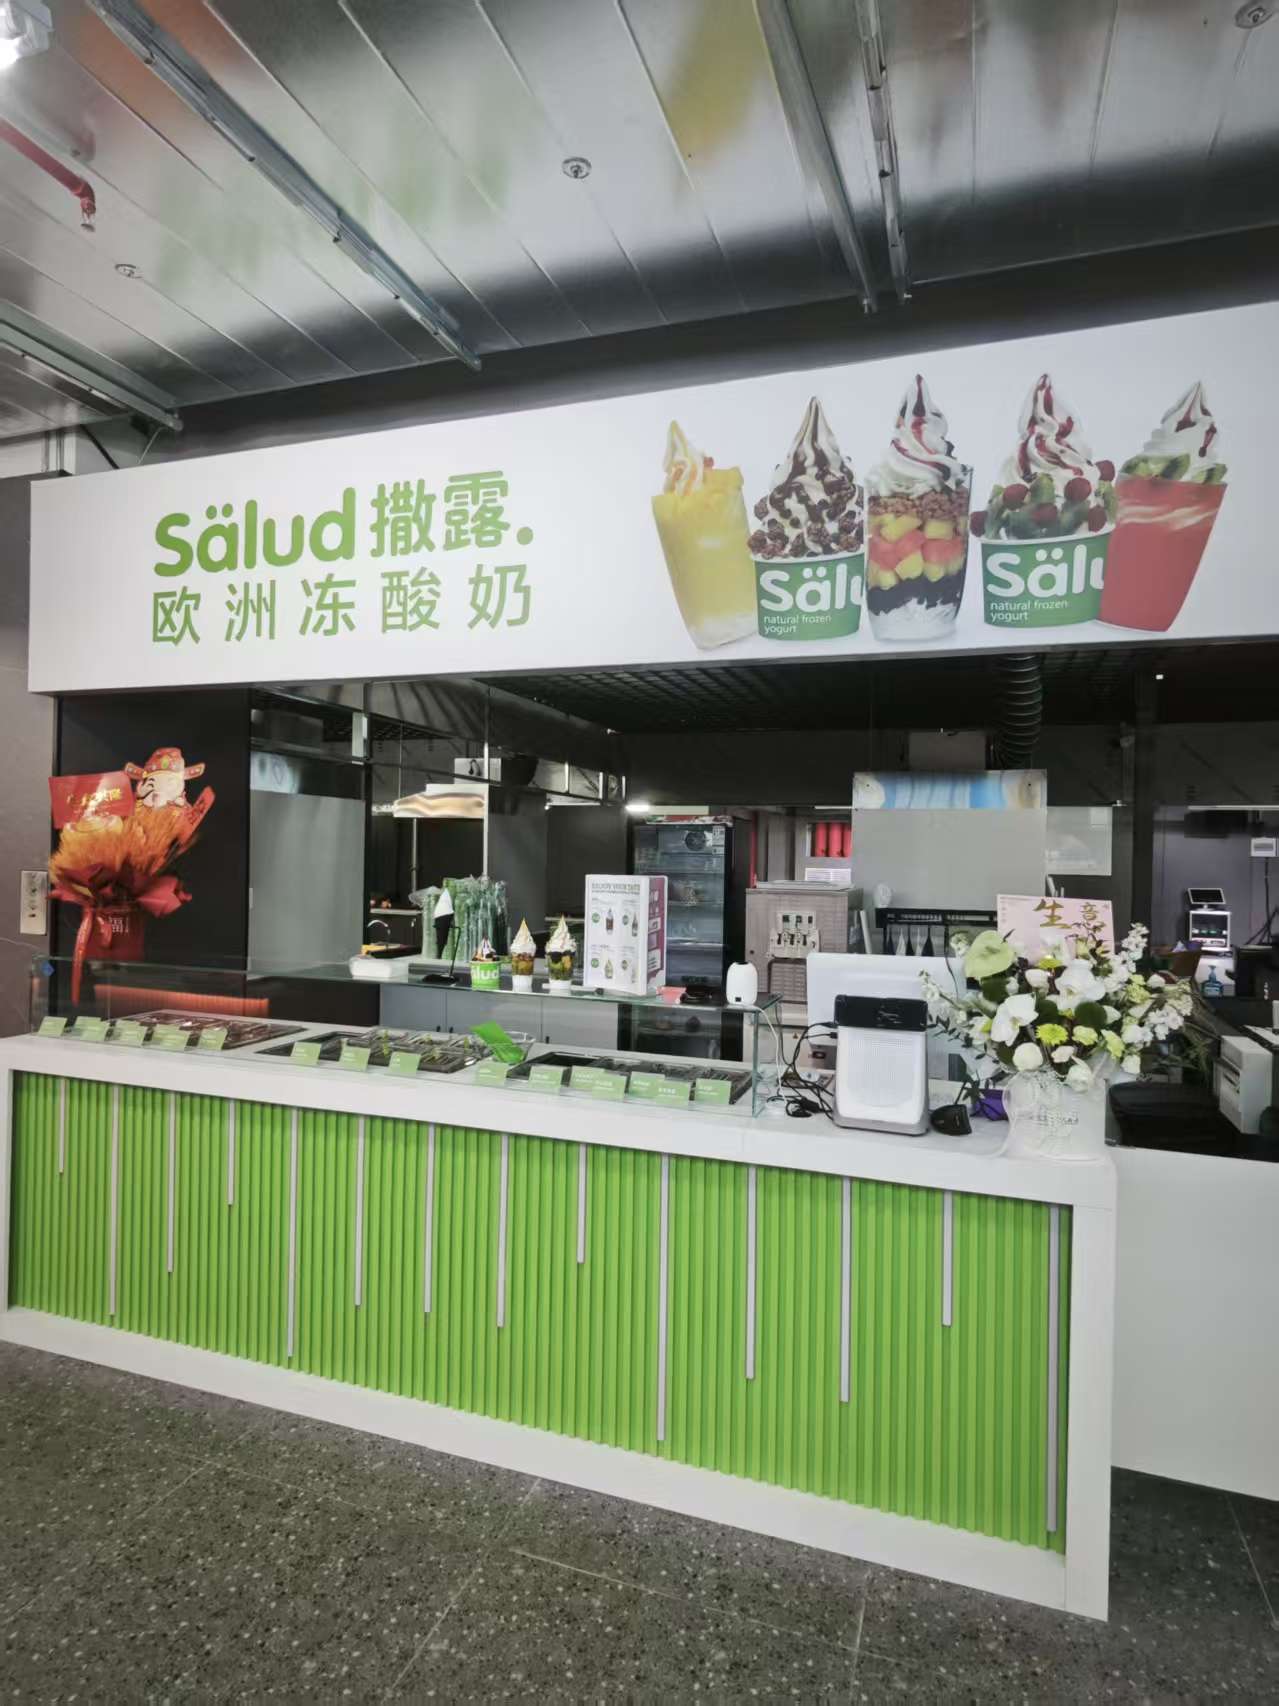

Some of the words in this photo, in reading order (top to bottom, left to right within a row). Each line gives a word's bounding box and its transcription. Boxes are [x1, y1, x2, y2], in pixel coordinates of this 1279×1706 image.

[154, 487, 356, 577] Sälud
[152, 563, 532, 646] 欧洲冻酸奶
[990, 600, 1031, 611] natural
[1034, 599, 1069, 609] frozen
[763, 614, 800, 625] natural
[801, 614, 832, 625] frozen
[990, 611, 1029, 623] yogurt
[764, 625, 798, 636] yogurt
